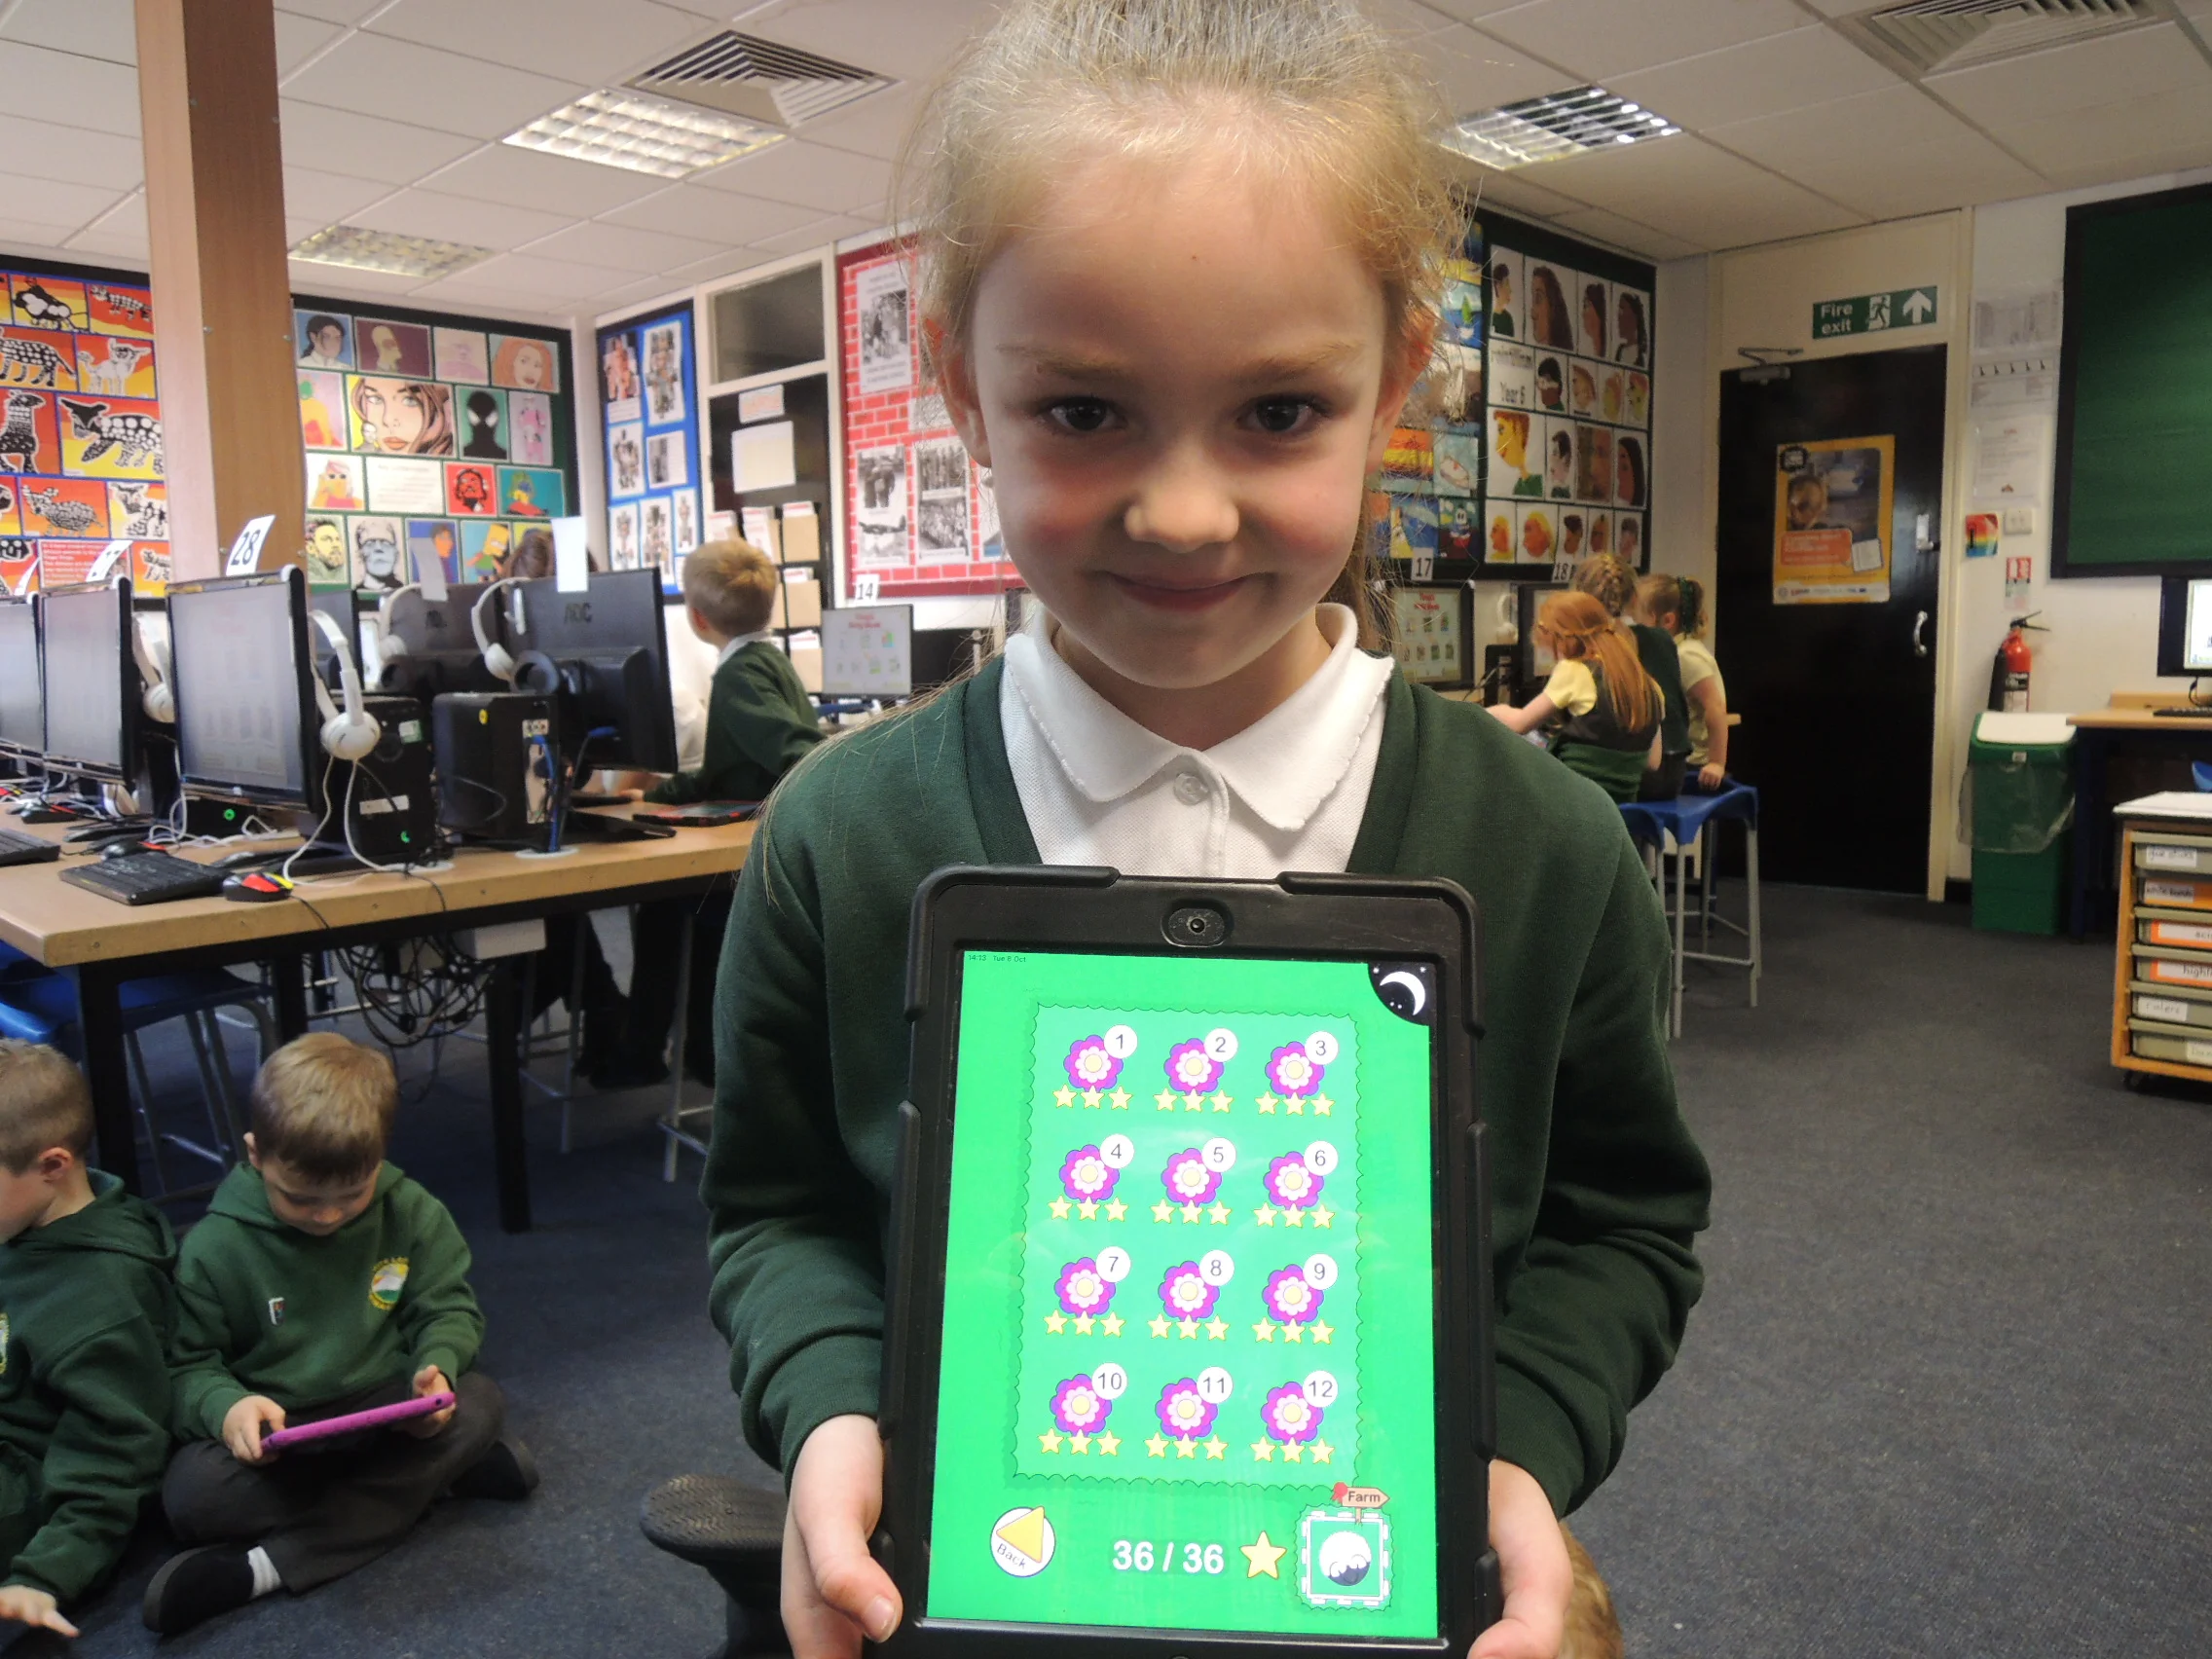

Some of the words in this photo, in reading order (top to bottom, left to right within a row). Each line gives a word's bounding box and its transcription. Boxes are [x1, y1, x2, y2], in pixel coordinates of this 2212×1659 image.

[1821, 303, 1853, 319] Fire
[1822, 319, 1852, 334] exit
[231, 530, 261, 566] 28
[1415, 558, 1431, 577] 17
[1554, 563, 1568, 580] 18
[857, 582, 873, 600] 14
[1115, 1034, 1124, 1050] 1
[1215, 1036, 1226, 1052] 2
[1315, 1040, 1326, 1055] 3
[1111, 1143, 1123, 1160] 4
[1213, 1147, 1224, 1163] 5
[1314, 1150, 1326, 1166] 6
[1108, 1256, 1119, 1272] 7
[1210, 1259, 1222, 1276] 8
[1314, 1263, 1325, 1280] 9
[1097, 1373, 1123, 1390] 10
[1203, 1377, 1225, 1393] 11
[1309, 1381, 1333, 1397] 12
[1347, 1491, 1381, 1502] Farm
[997, 1543, 1026, 1569] Back
[1112, 1540, 1154, 1571] 36
[1182, 1543, 1224, 1574] 36
